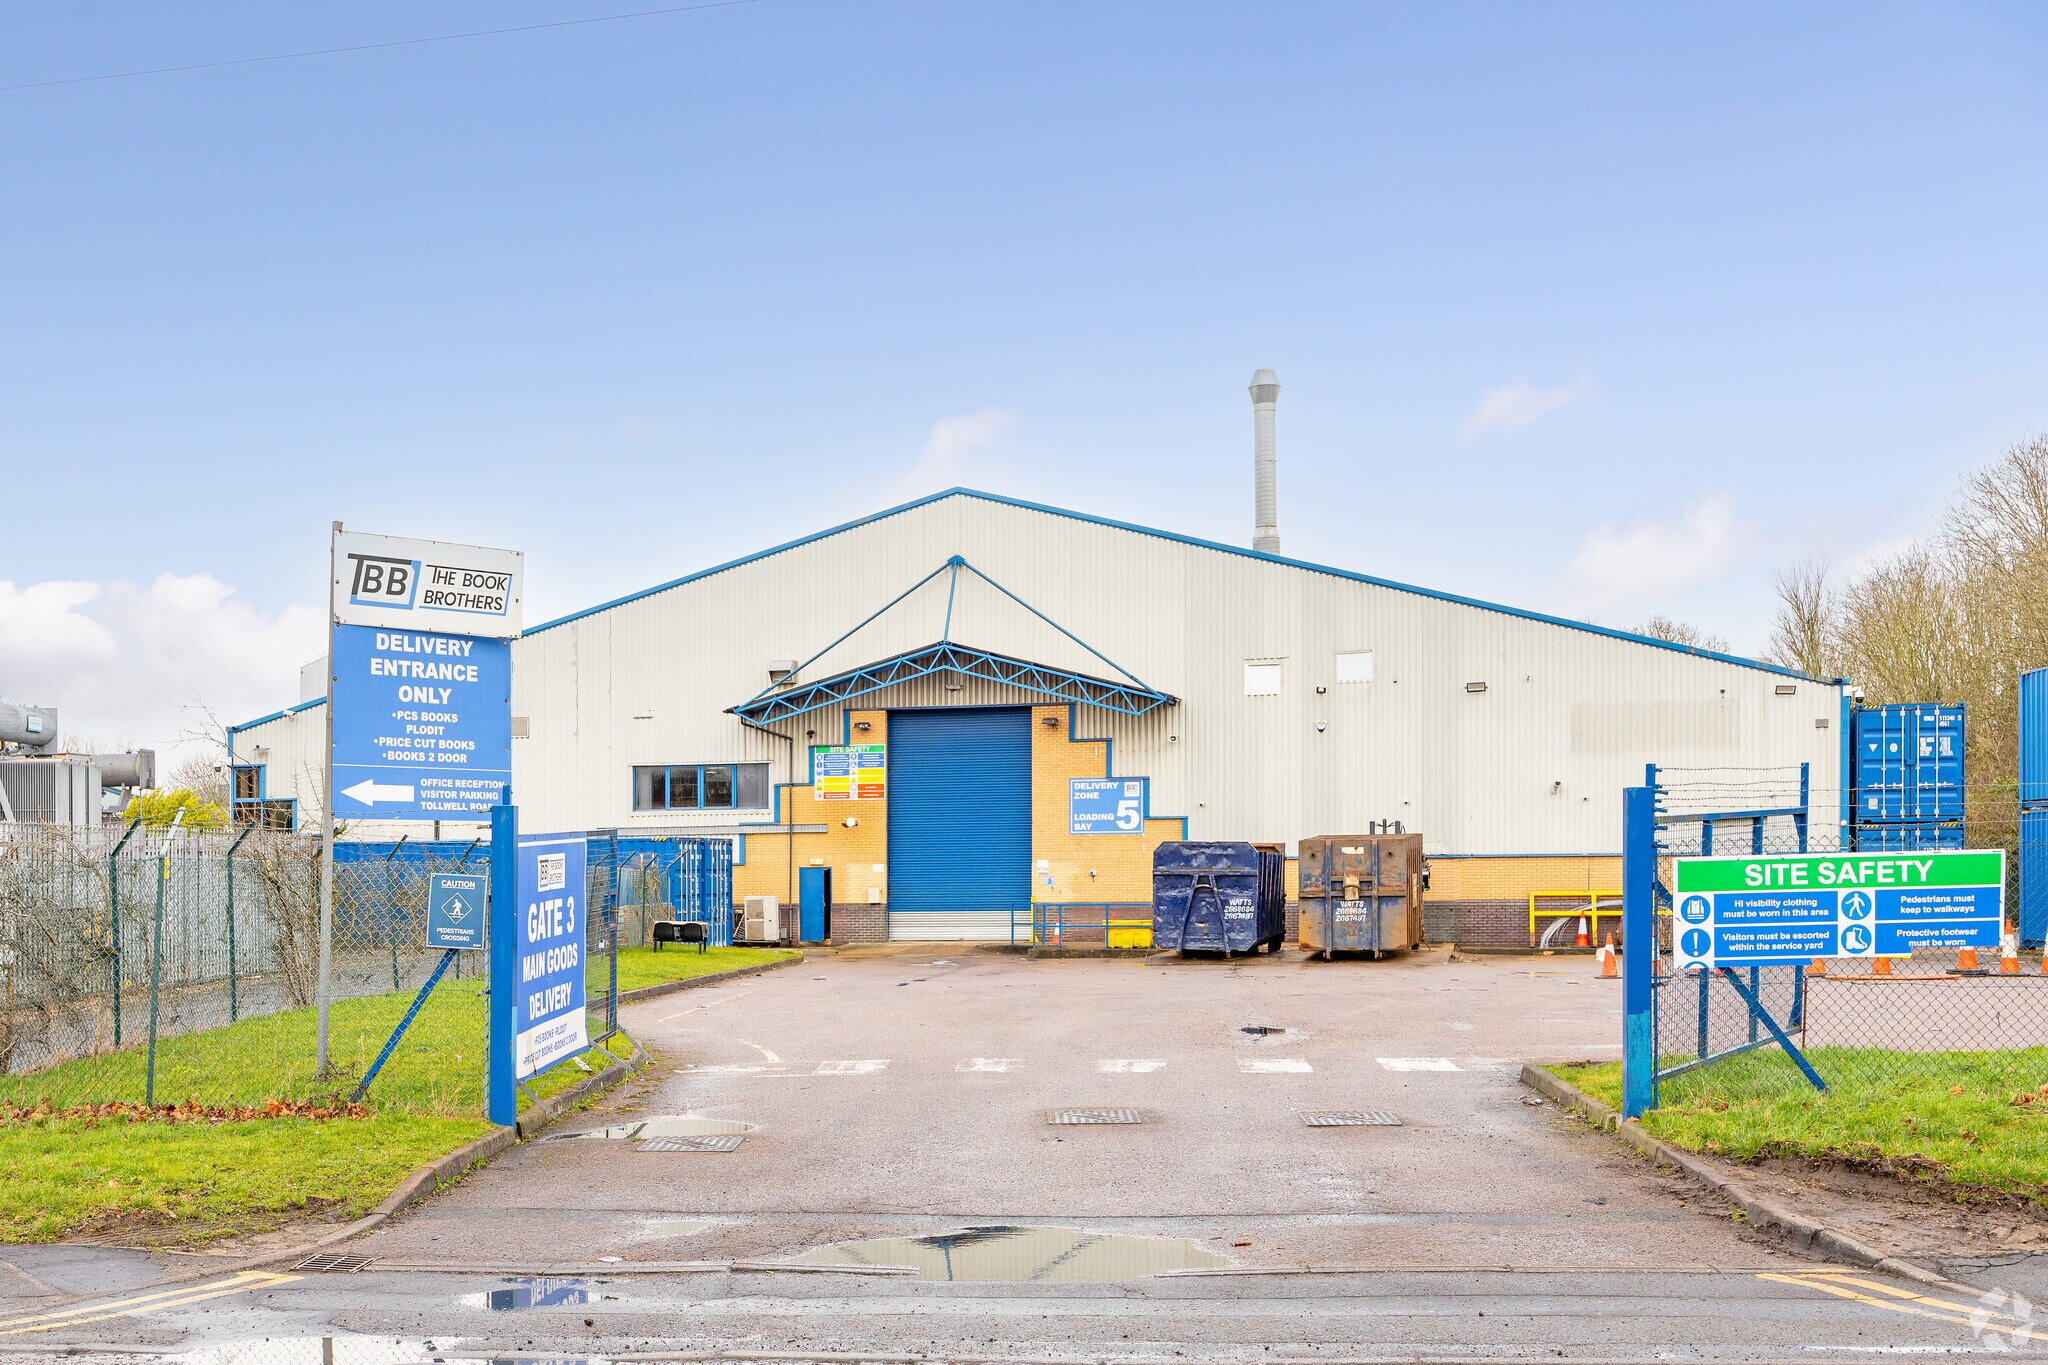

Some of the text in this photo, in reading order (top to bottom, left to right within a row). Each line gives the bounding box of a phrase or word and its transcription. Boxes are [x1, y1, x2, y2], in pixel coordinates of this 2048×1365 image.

[426, 565, 508, 591] THE BOOK
[423, 590, 503, 610] BROTHERS
[376, 633, 473, 657] DELIVERY
[370, 658, 478, 682] ENTRANCE
[398, 685, 452, 704] ONLY
[421, 712, 458, 722] BOOKS
[406, 725, 445, 735] PLODIT
[414, 738, 436, 748] CUT
[439, 740, 475, 750] BOOKS
[428, 752, 435, 762] 2
[438, 753, 467, 763] DOOR
[421, 778, 504, 789] OFFICE RECEPTION
[1074, 782, 1118, 790] DELIVERY
[421, 790, 499, 800] VISITOR PARKING
[1074, 792, 1099, 800] ZONE
[421, 801, 467, 811] TOLLWELL
[1074, 813, 1114, 821] LOADING
[1115, 800, 1140, 830] 5
[1074, 823, 1092, 831] BAY
[1745, 859, 1934, 887] SITE SAFETY
[441, 879, 475, 888] CAUTION
[1746, 899, 1780, 908] visibility
[1783, 899, 1817, 908] clothing
[1900, 894, 1975, 903] Pedestrians must
[1723, 910, 1744, 918] must
[1792, 908, 1808, 916] this
[1900, 906, 1921, 914] keep
[1934, 905, 1975, 914] walkways
[527, 895, 575, 944] GATE 3
[436, 927, 474, 935] PEDESTRIANS
[1723, 933, 1754, 941] Visitors
[1780, 932, 1790, 940] be
[1792, 931, 1829, 939] escorted
[1896, 928, 1978, 937] Protective footwear
[1729, 941, 1823, 951] within the service yard
[1908, 939, 1930, 947] must
[523, 942, 578, 983] MAIN GOODS
[529, 981, 572, 1021] DELIVERY
